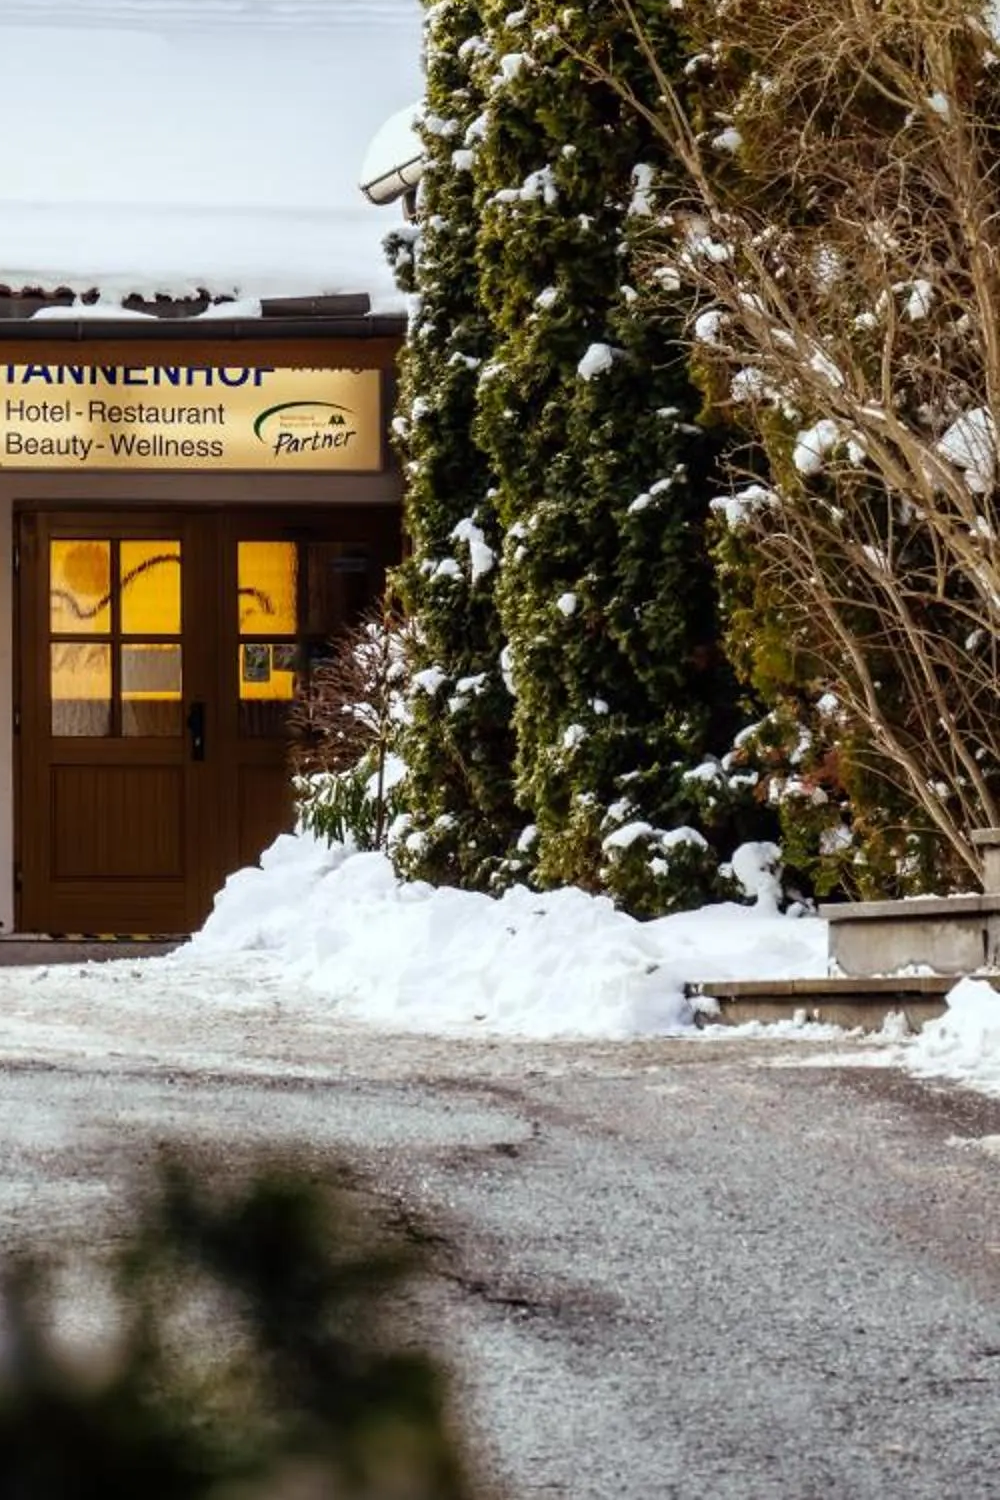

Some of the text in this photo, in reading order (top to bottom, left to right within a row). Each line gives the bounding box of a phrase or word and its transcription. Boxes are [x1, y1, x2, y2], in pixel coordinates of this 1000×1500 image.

[5, 399, 71, 423] Hotel
[88, 400, 225, 425] Restaurant
[5, 432, 94, 460] Beauty
[109, 432, 224, 458] Wellness
[273, 430, 357, 457] Partner
